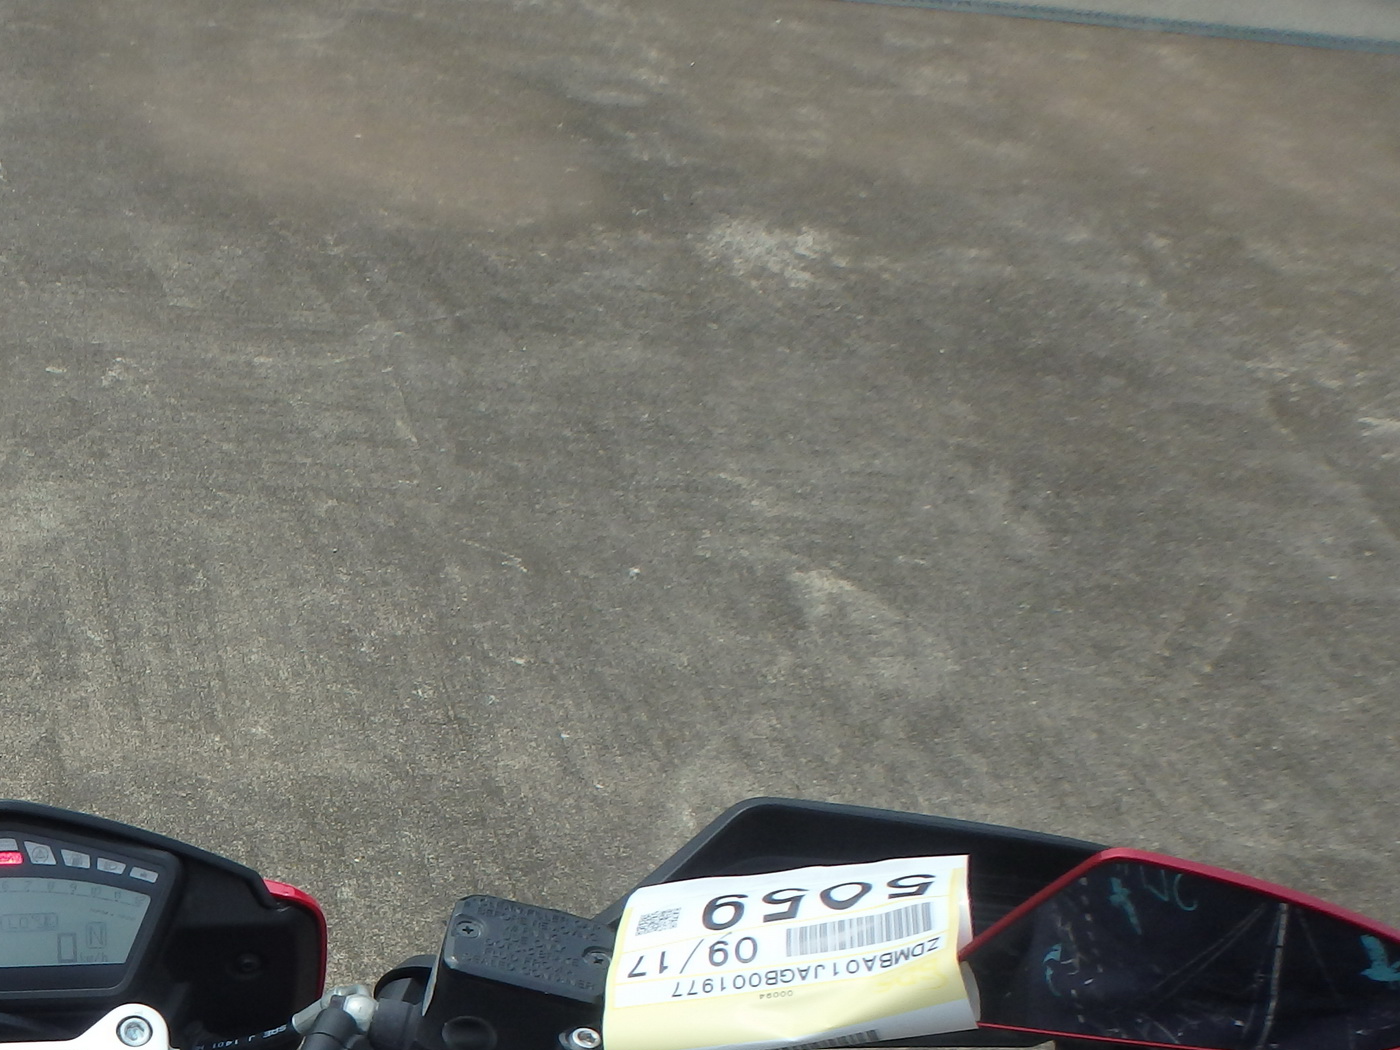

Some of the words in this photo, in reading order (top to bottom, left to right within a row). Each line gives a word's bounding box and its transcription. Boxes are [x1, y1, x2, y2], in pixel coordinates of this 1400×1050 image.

[701, 873, 937, 931] 5059
[57, 932, 77, 963] 0
[627, 935, 758, 979] 09/17
[671, 936, 941, 998] ZDMBA01JAGB001977
